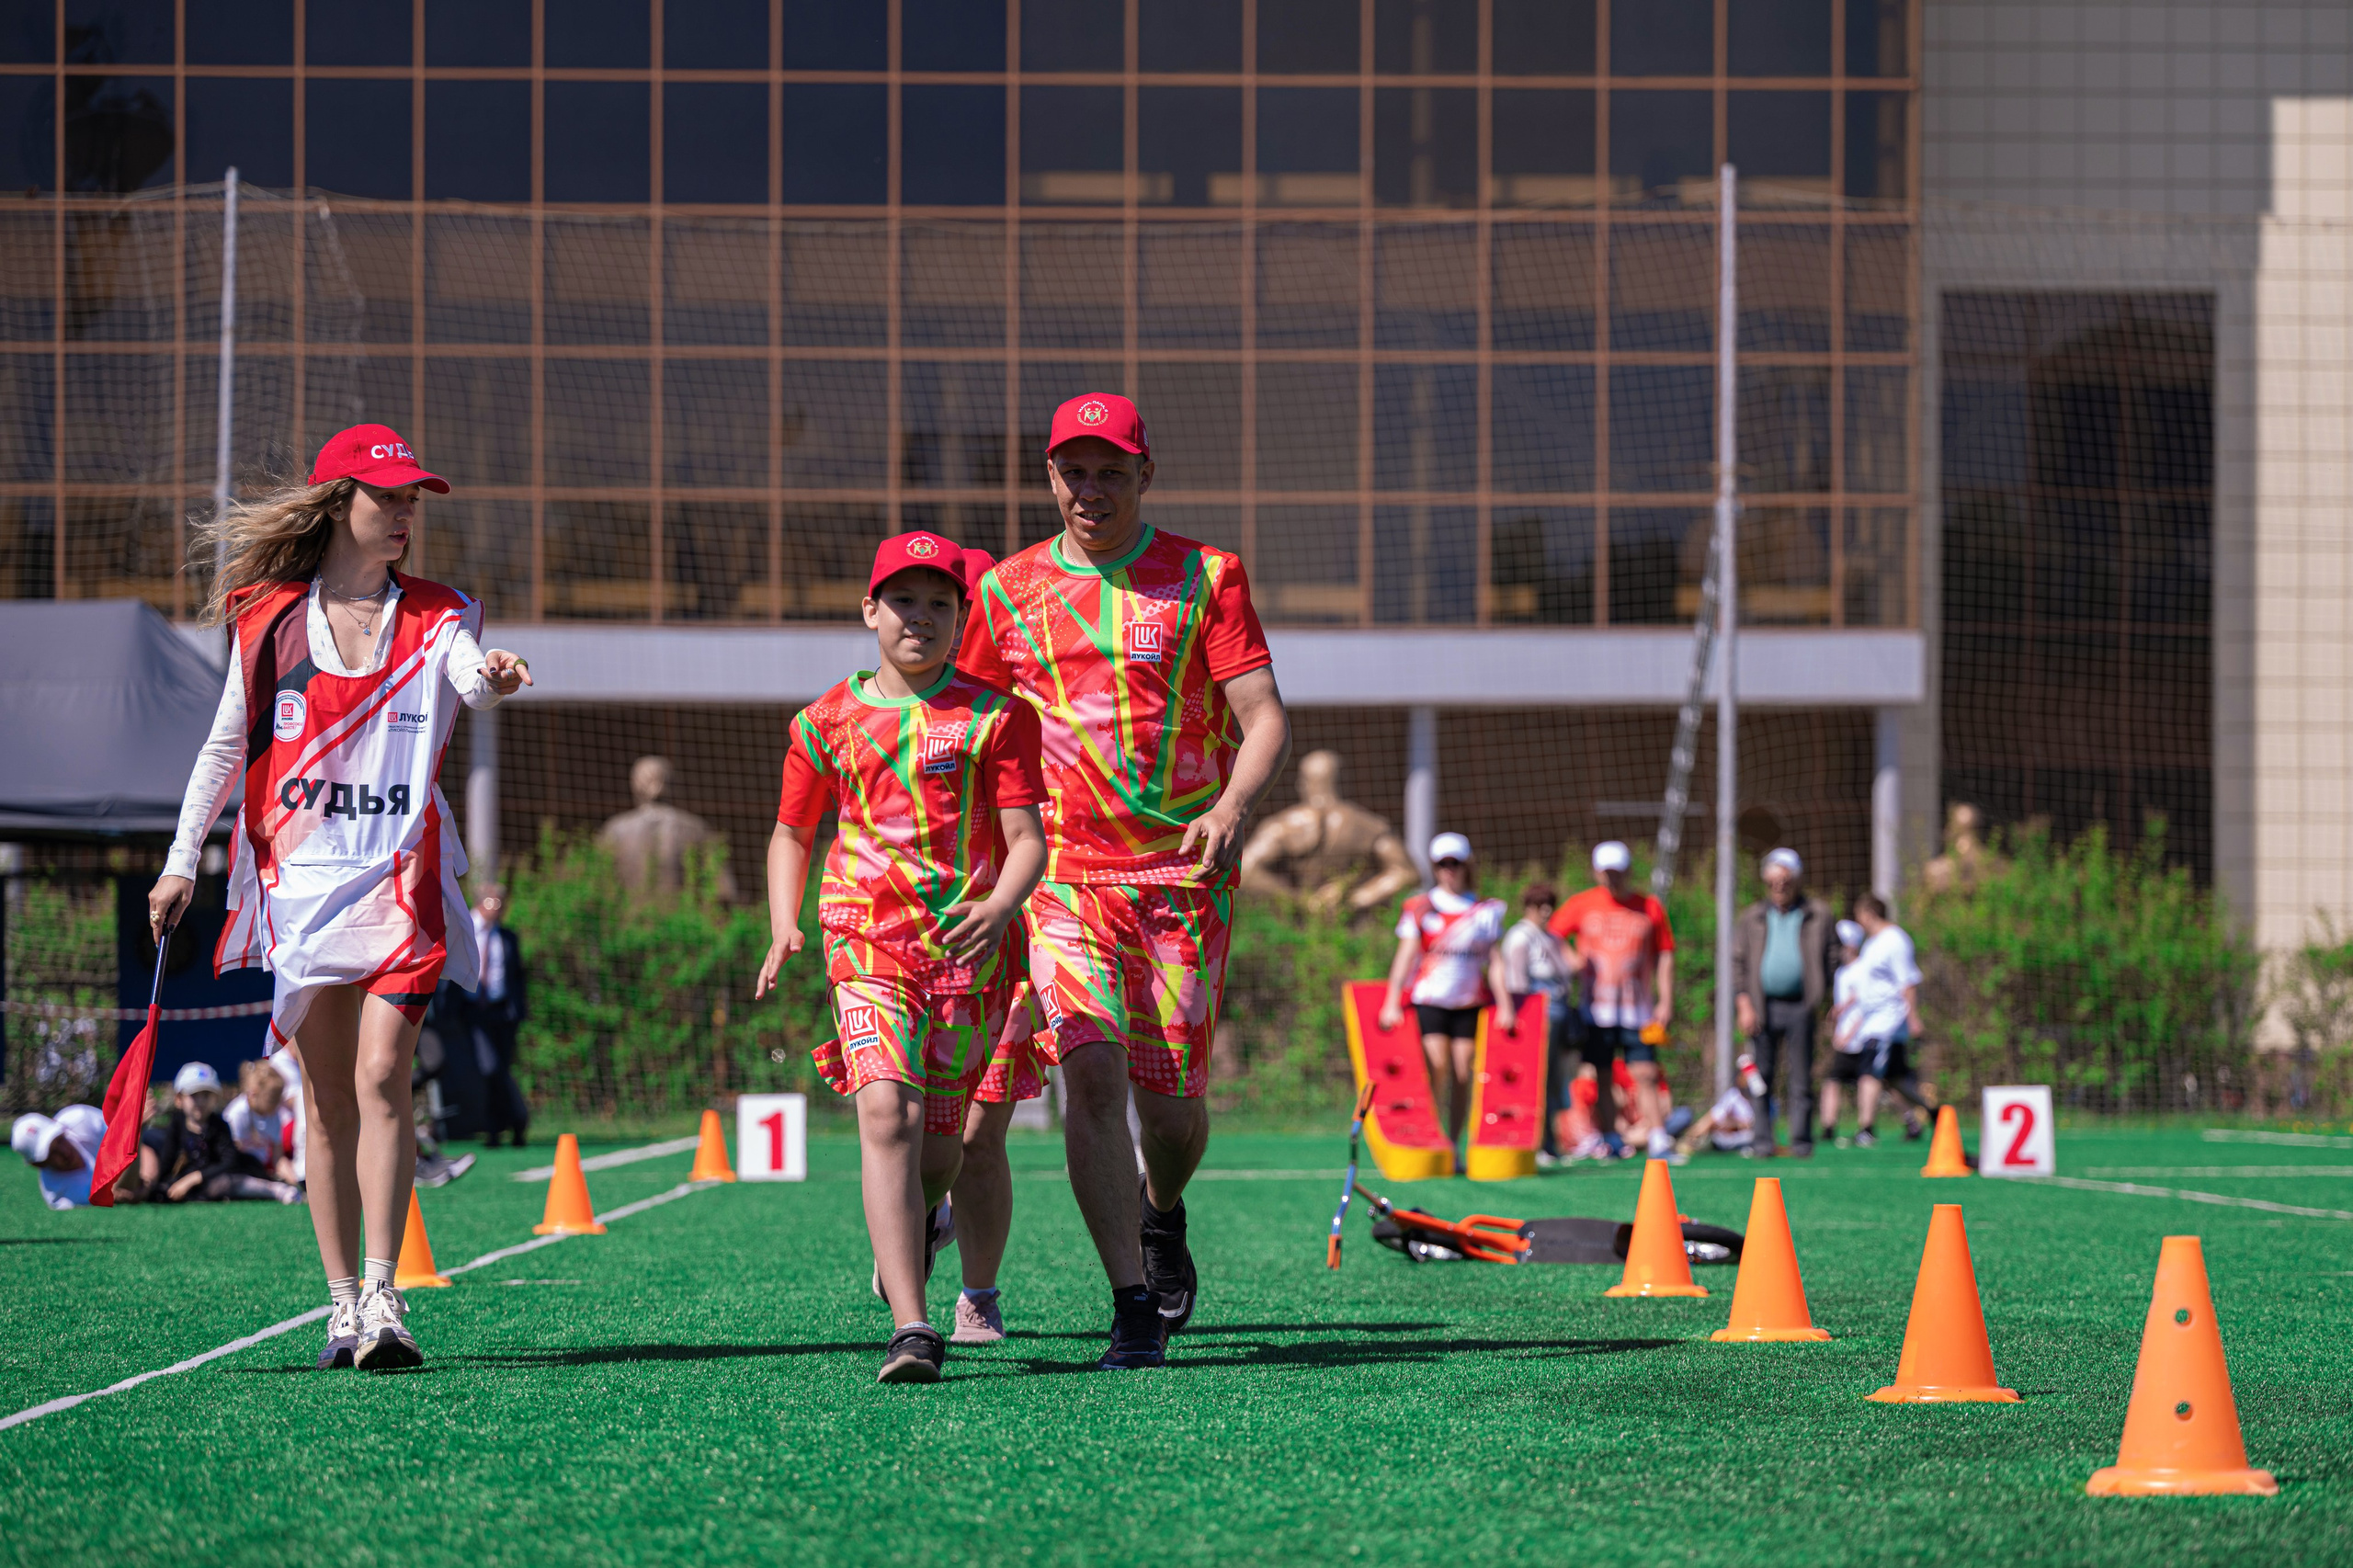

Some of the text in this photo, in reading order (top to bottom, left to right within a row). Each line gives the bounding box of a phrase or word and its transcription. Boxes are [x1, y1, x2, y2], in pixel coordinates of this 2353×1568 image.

[1131, 653, 1161, 661] ЛУКОЙЛ
[926, 763, 956, 772] ЛУКОЙЛ
[281, 778, 411, 821] СУДЬЯ
[850, 1037, 879, 1050] ЛУКОЙЛ
[757, 1110, 783, 1171] 1
[2001, 1103, 2036, 1166] 2
